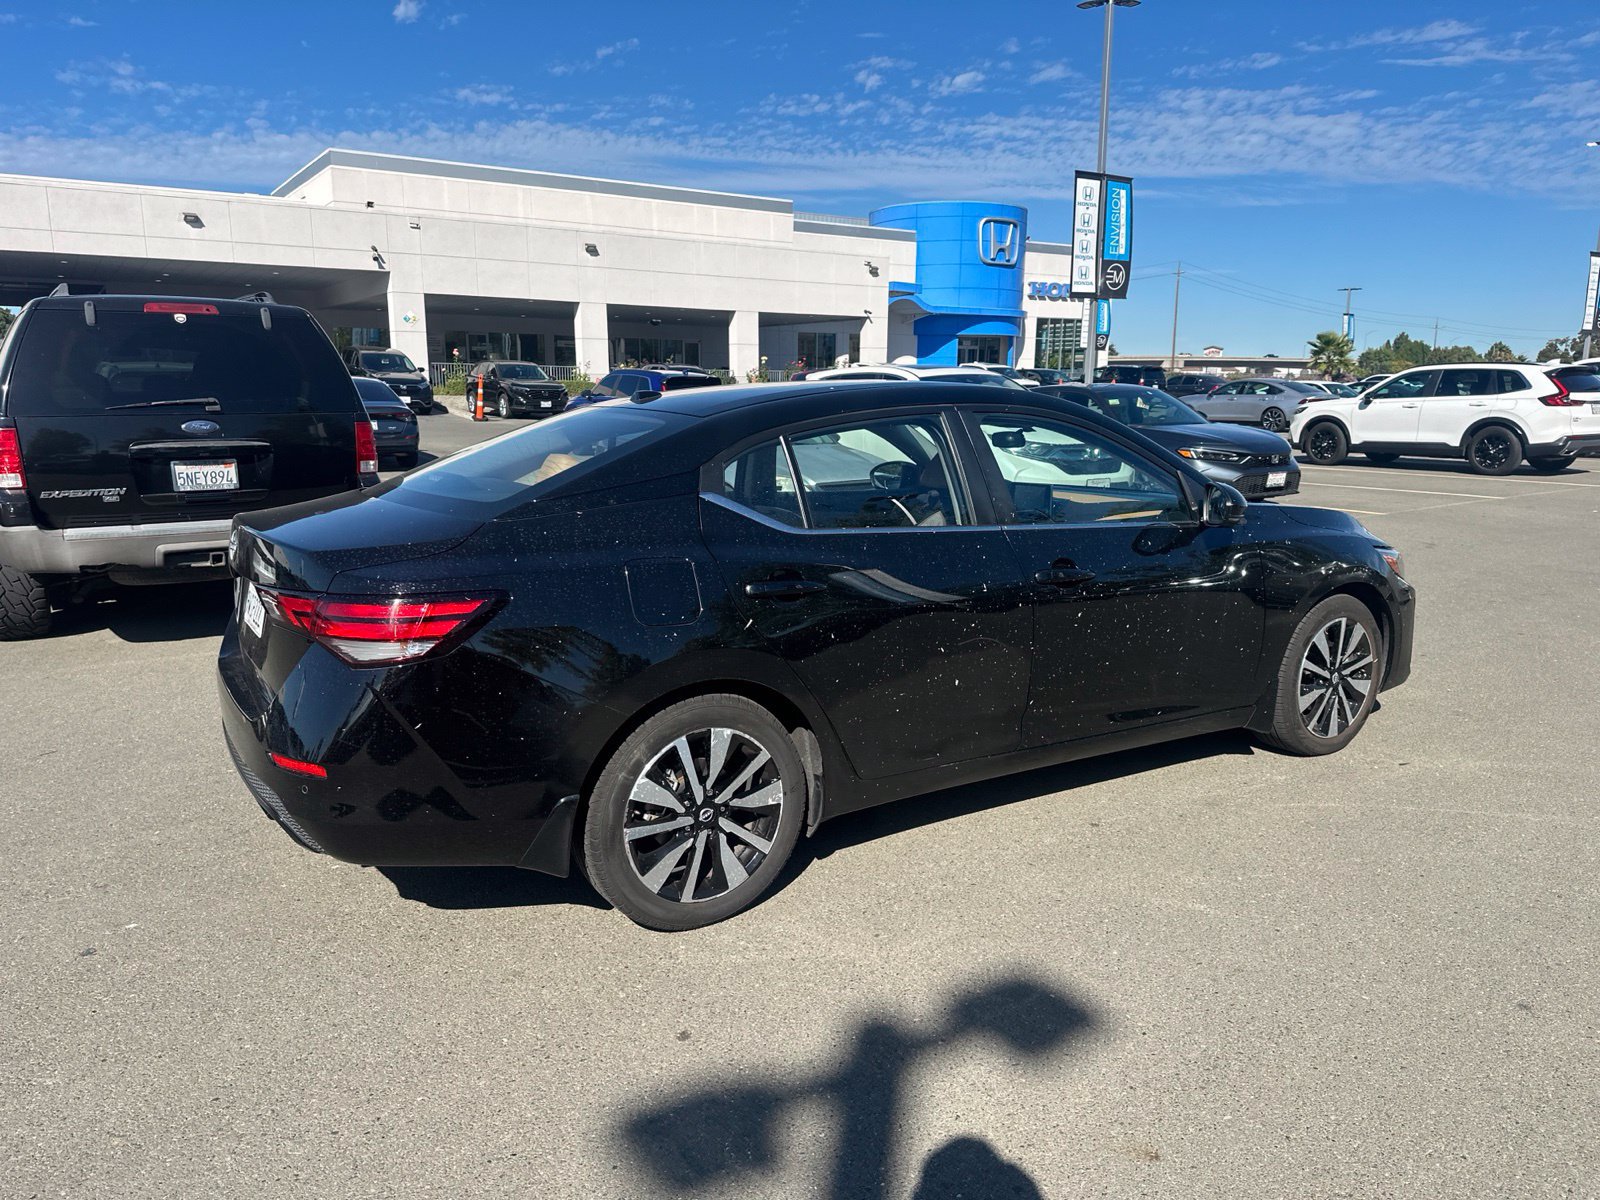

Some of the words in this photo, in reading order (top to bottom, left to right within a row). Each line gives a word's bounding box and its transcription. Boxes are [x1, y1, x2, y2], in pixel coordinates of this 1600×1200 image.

[1109, 187, 1120, 254] ENVISION
[1029, 281, 1070, 297] HON
[190, 422, 211, 431] Ford
[177, 470, 234, 486] 5NEY894
[40, 487, 127, 499] EXPEDITION
